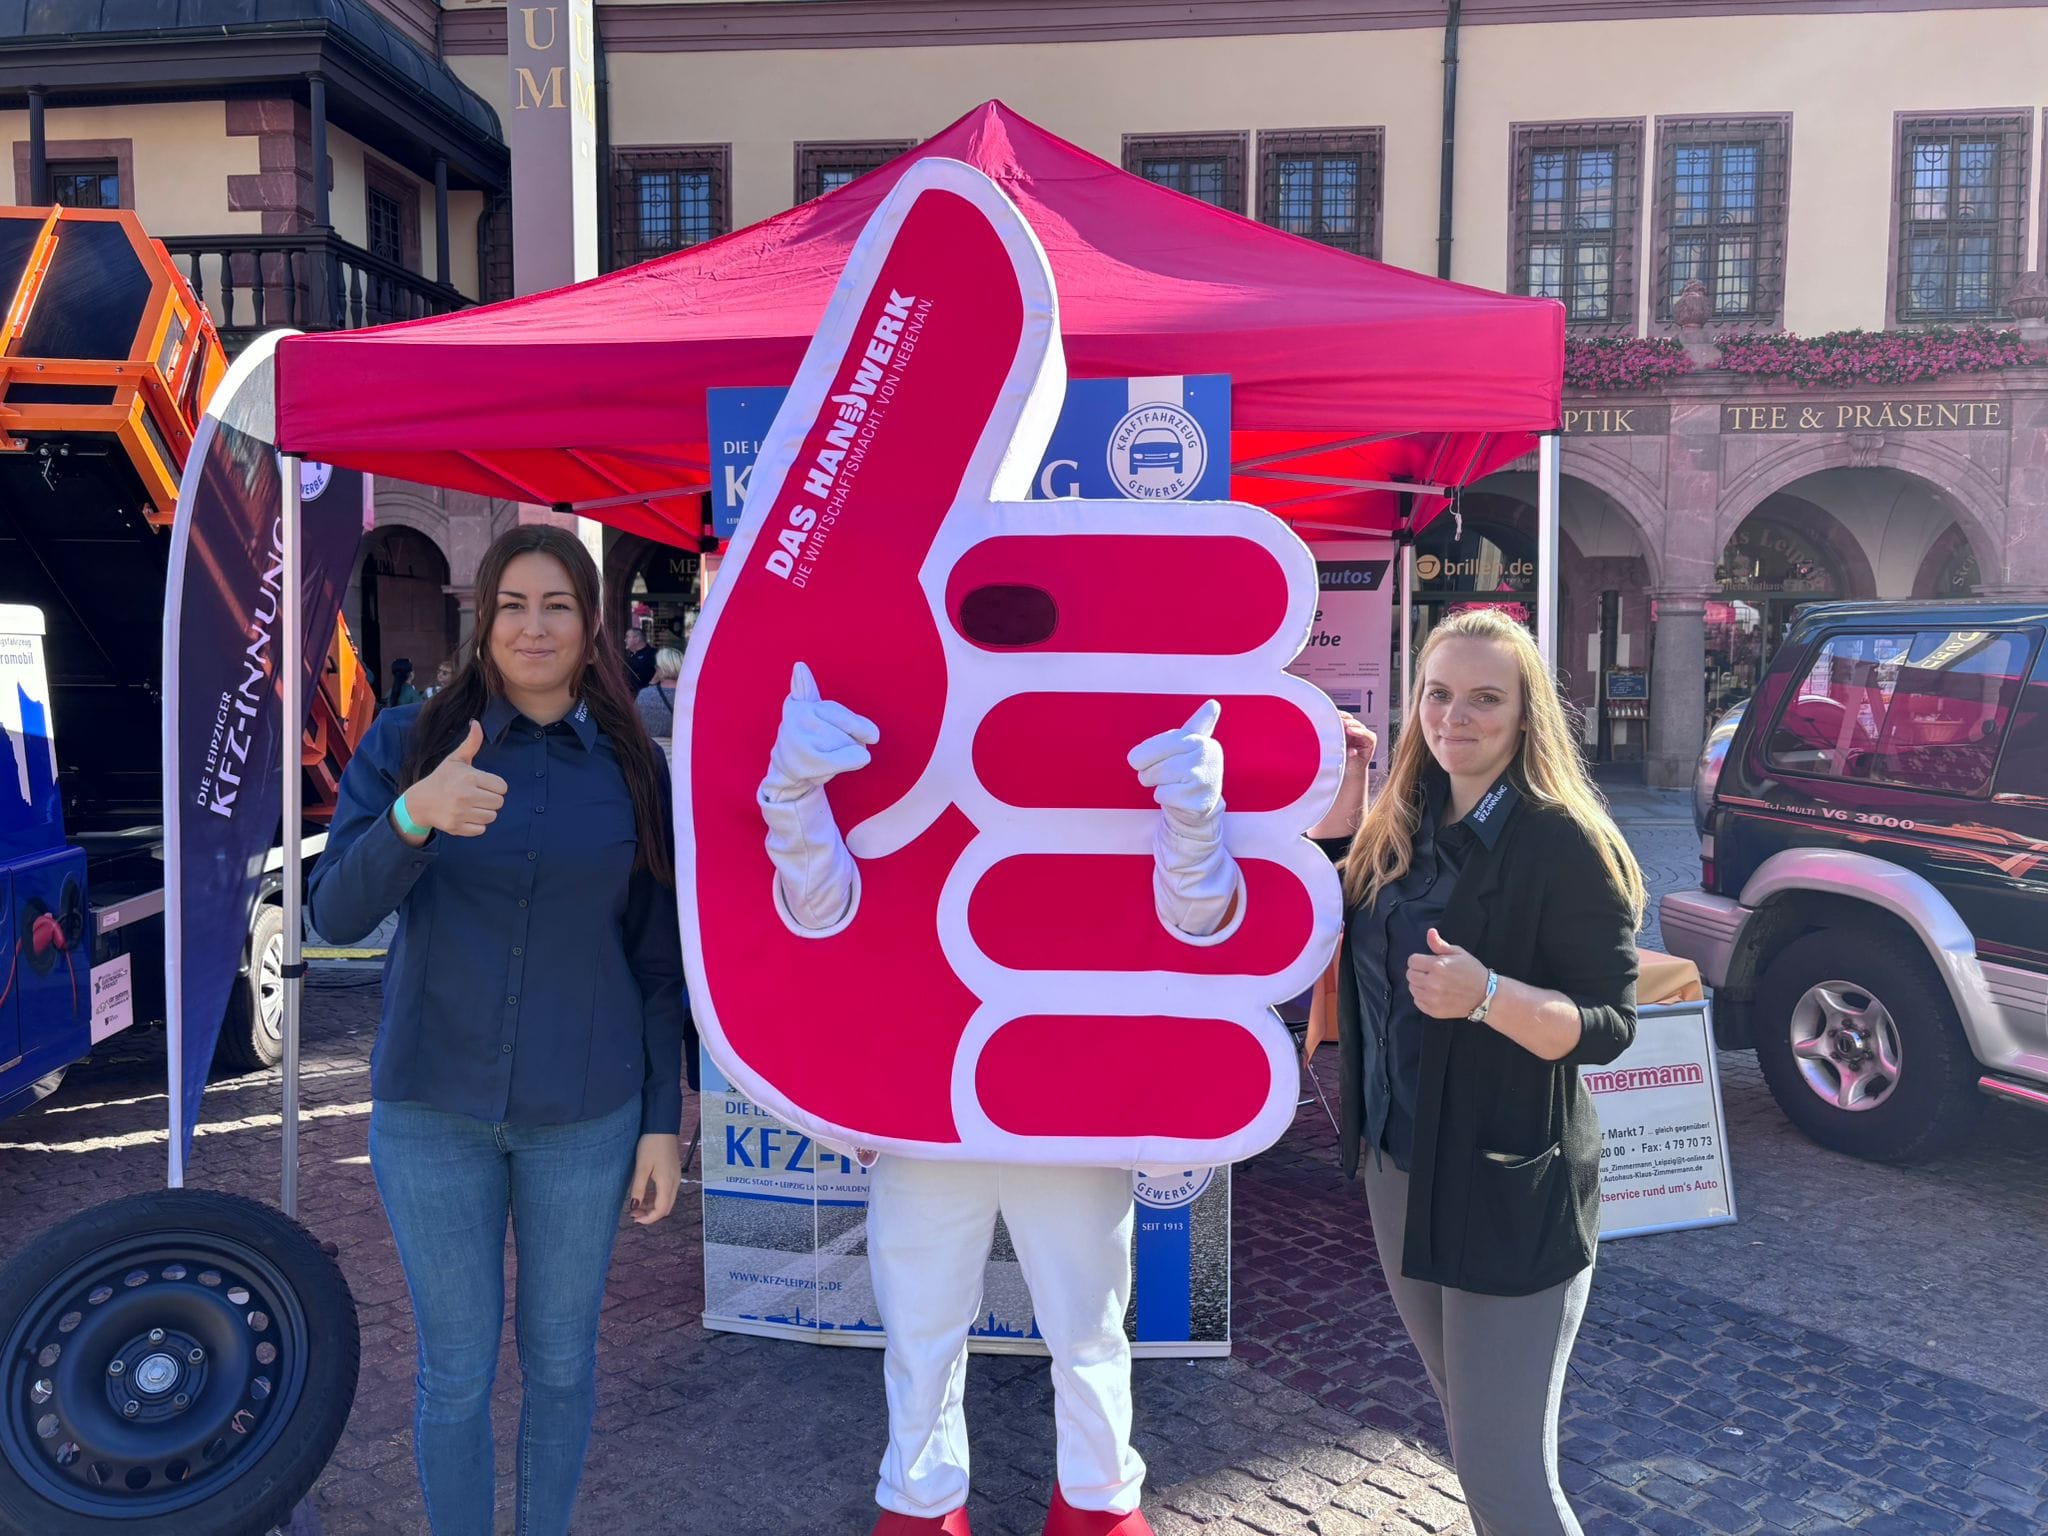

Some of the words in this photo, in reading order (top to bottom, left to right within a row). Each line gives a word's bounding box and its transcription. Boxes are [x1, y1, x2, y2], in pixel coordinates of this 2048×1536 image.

[575, 0, 594, 126] UM
[892, 298, 934, 372] NEBENAN.
[876, 374, 901, 405] VON
[1563, 409, 1635, 432] PTIK
[1727, 407, 1788, 430] TEE
[1799, 405, 1825, 429] &
[1836, 402, 2002, 428] PRÄSENTE
[1116, 411, 1198, 451] KRAFTFAHRZEUG
[723, 440, 749, 454] DIE
[754, 440, 766, 454] L
[301, 475, 325, 495] ERBE
[802, 408, 887, 565] WIRTSCHAFTSMACHT.
[1128, 477, 1186, 498] GEWERBE
[765, 504, 817, 580] DAS
[792, 563, 814, 589] DIE
[1320, 570, 1372, 584] autos
[1444, 558, 1534, 576] brillen.de
[1306, 630, 1342, 647] rbe
[204, 690, 232, 775] LEIPZIGER
[197, 775, 212, 807] DIE
[1821, 807, 1848, 820] V6
[1853, 812, 1915, 830] 3000
[725, 1101, 749, 1115] DIE
[753, 1104, 773, 1118] LE
[1608, 1127, 1637, 1139] Markt
[1639, 1125, 1645, 1136] 7
[1655, 1124, 1674, 1136] gleich
[1675, 1121, 1710, 1133] gegenüber!
[725, 1125, 867, 1175] KFZ-I
[1601, 1148, 1611, 1159] 20
[1614, 1146, 1626, 1157] 00
[1641, 1142, 1662, 1154] Fax:
[1664, 1141, 1670, 1151] 4
[1673, 1139, 1685, 1150] 79
[1687, 1137, 1699, 1148] 70
[1701, 1136, 1713, 1147] 73
[726, 1176, 751, 1185] LEIPZIG
[752, 1178, 773, 1187] STADT
[780, 1180, 805, 1190] LEIPZIG
[806, 1184, 829, 1192] LAND
[1137, 1181, 1195, 1200] GEWERBE
[1643, 1184, 1666, 1197] rund
[1668, 1182, 1692, 1194] um's
[1694, 1179, 1718, 1190] Auto
[1142, 1222, 1160, 1231] SEIT
[1163, 1222, 1184, 1231] 1913
[729, 1271, 842, 1291] WWW.KFZ-LEIPZIG.DE
